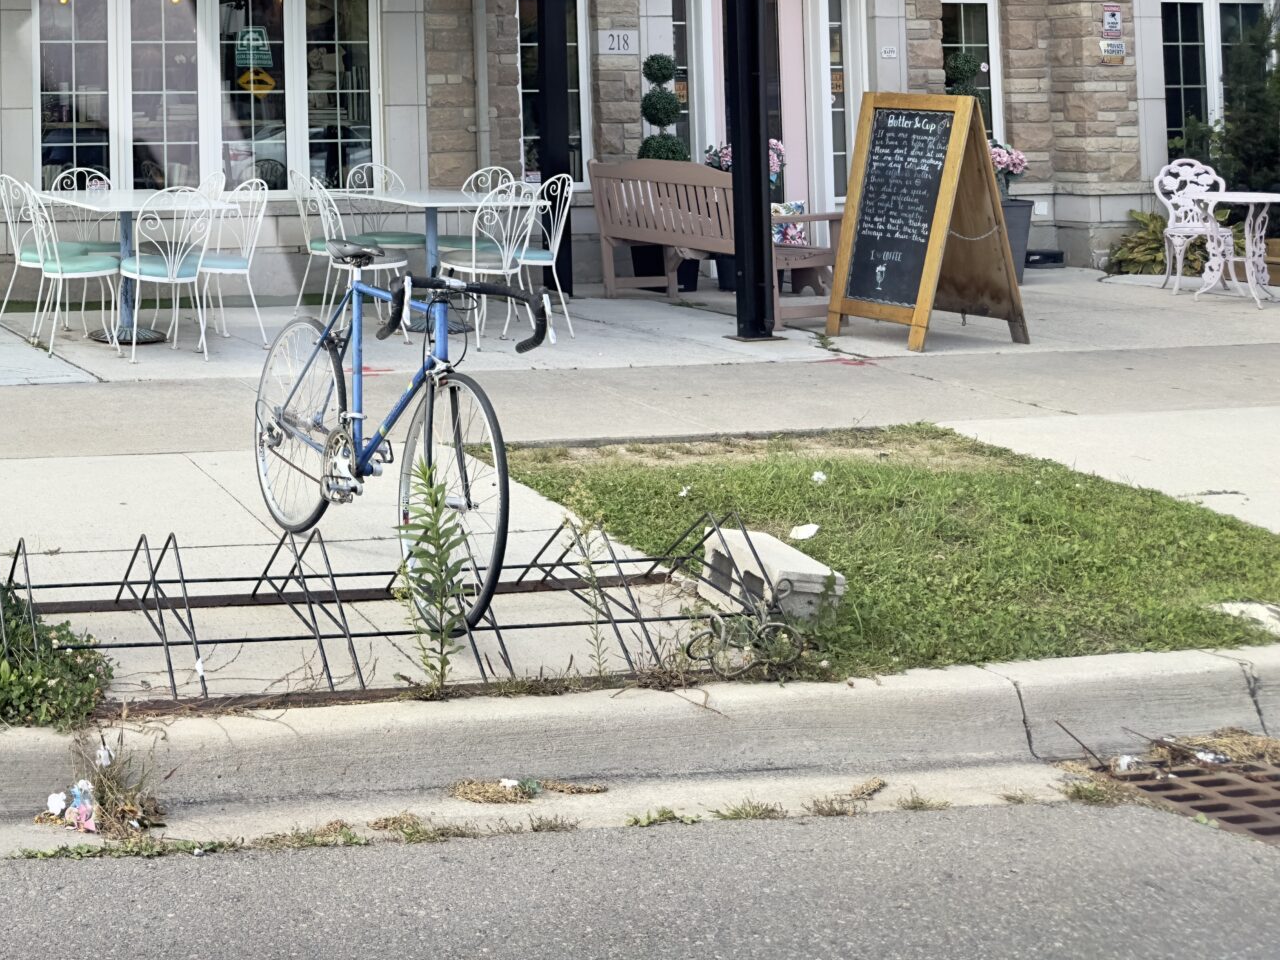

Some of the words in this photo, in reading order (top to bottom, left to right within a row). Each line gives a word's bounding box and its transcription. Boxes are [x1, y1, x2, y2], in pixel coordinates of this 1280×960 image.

[608, 34, 629, 50] 218
[888, 115, 912, 128] Butter
[913, 116, 920, 128] &
[921, 119, 936, 133] Cup
[889, 162, 901, 173] day
[862, 229, 882, 240] always
[883, 251, 902, 261] COFFEE
